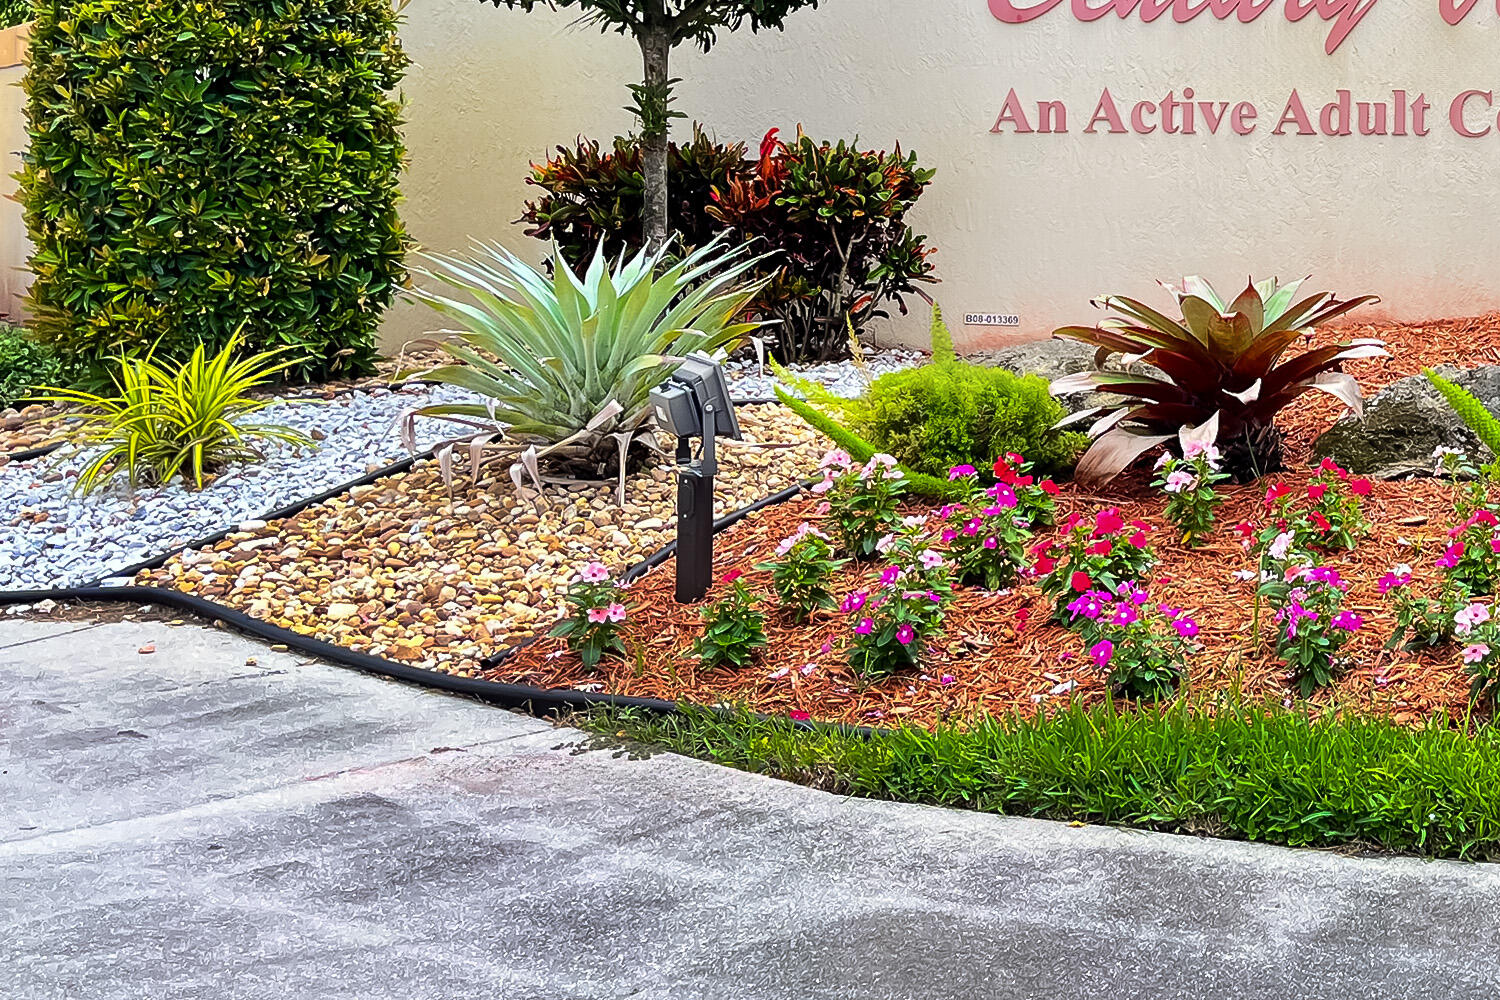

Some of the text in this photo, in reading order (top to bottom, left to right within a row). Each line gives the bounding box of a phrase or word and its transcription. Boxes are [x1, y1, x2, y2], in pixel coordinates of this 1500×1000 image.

[989, 88, 1068, 136] An
[1083, 87, 1258, 137] Active
[1273, 89, 1431, 137] Adult
